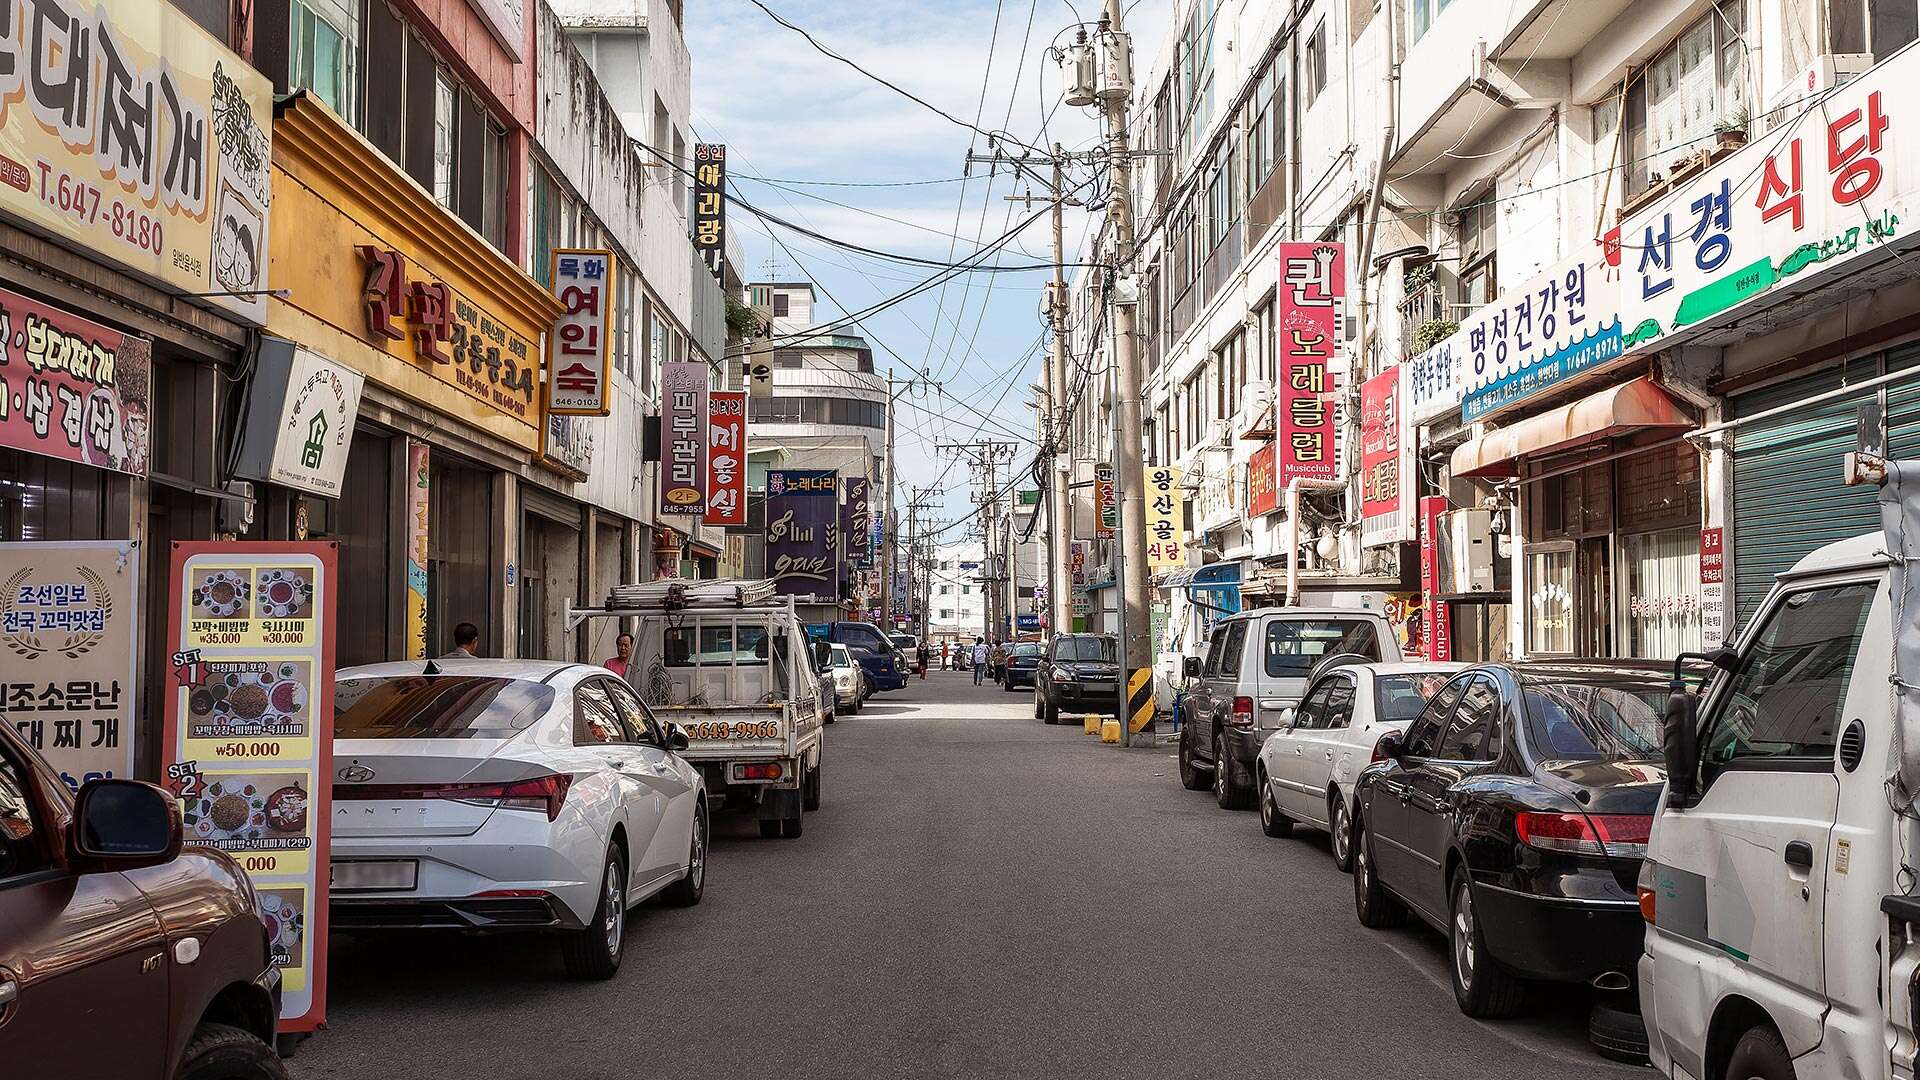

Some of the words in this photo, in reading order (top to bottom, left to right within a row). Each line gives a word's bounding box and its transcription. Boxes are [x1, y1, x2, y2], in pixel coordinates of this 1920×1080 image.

[696, 146, 724, 160] 성인
[1638, 178, 1733, 301] 선경
[1755, 90, 1889, 232] 식당
[37, 160, 163, 256] T.647-8180
[559, 258, 604, 279] 목화
[1285, 247, 1336, 307] 퀸
[354, 244, 456, 365] 간판
[1470, 262, 1586, 375] 명성건강원
[26, 313, 116, 386] 부대찌개
[557, 285, 600, 395] 여인숙
[555, 398, 599, 406] 646-0103
[1290, 329, 1327, 462] 노래클럽
[671, 391, 700, 487] 피부관리
[709, 422, 740, 518] 미용실
[1285, 463, 1331, 473] Musicclub
[664, 505, 704, 513] 645-7955
[1151, 469, 1176, 540] 왕산골
[1148, 541, 1180, 561] 식당
[1703, 533, 1719, 548] 경고
[18, 585, 87, 605] 조선일보
[4, 611, 36, 632] 전국
[39, 610, 104, 632] 꼬막맛집
[192, 621, 249, 632] 꼬막+비빔밥
[173, 649, 201, 667] SET
[188, 664, 198, 684] 1
[698, 721, 778, 739] 643-9966
[168, 761, 198, 779] SET
[180, 775, 197, 797] 2
